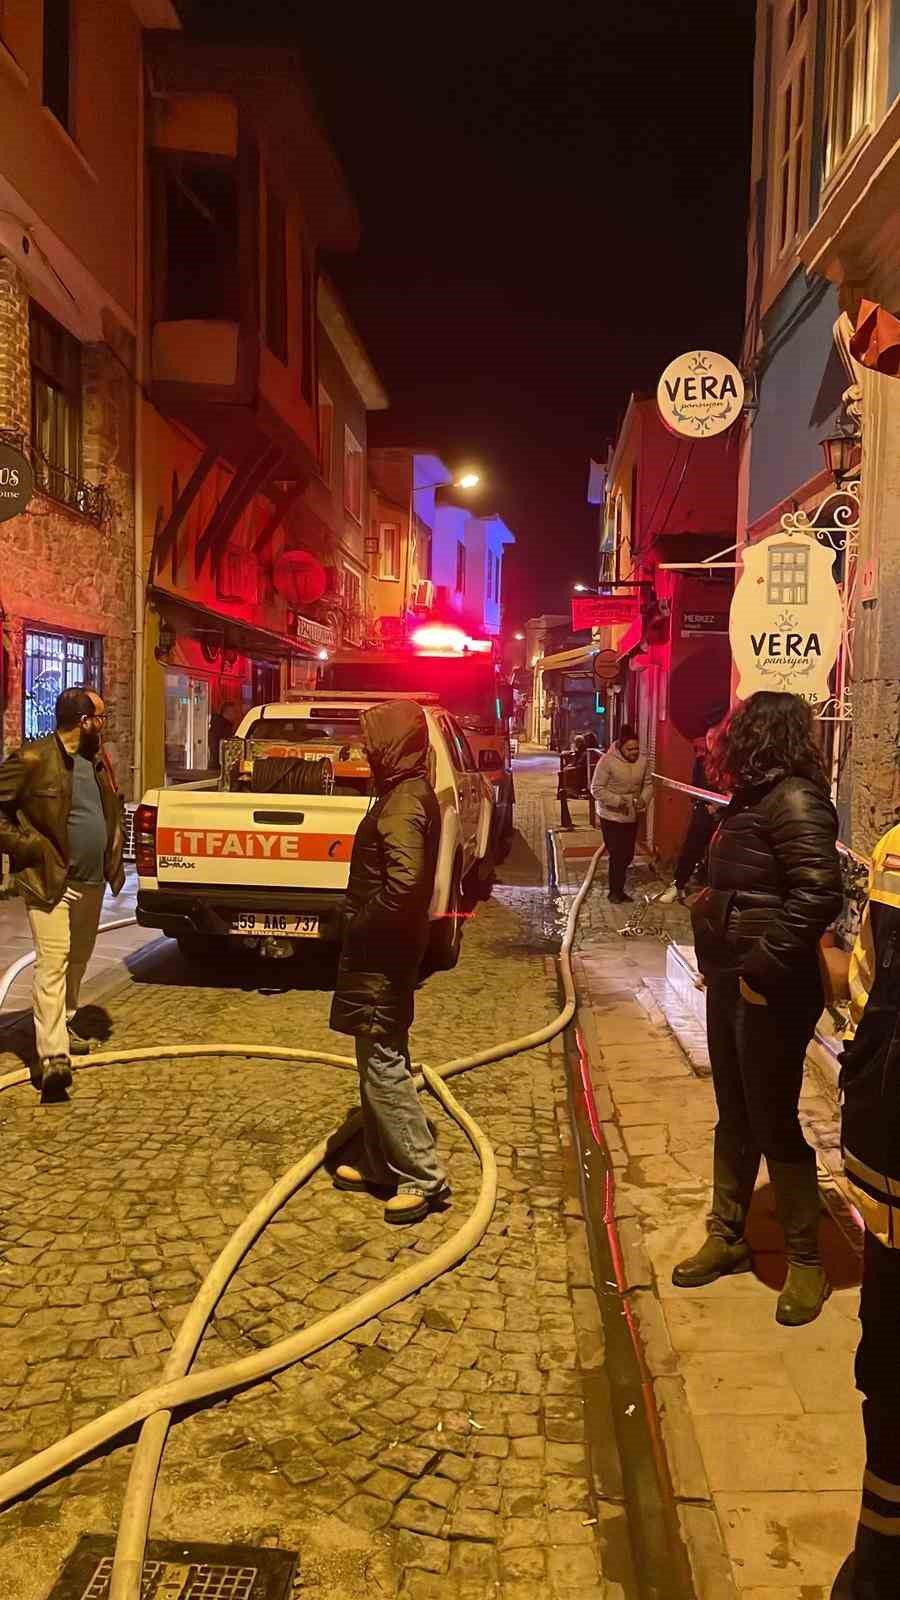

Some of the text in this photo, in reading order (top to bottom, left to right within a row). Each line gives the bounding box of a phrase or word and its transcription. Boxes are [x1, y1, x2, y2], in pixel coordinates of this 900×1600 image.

[664, 374, 737, 402] VERA
[681, 402, 723, 413] pansiyon
[750, 632, 821, 657] VERA
[763, 657, 809, 668] pansiyon
[808, 692, 818, 702] 75
[173, 831, 299, 858] İTFAİYE
[239, 914, 256, 929] 59
[295, 916, 317, 932] 737
